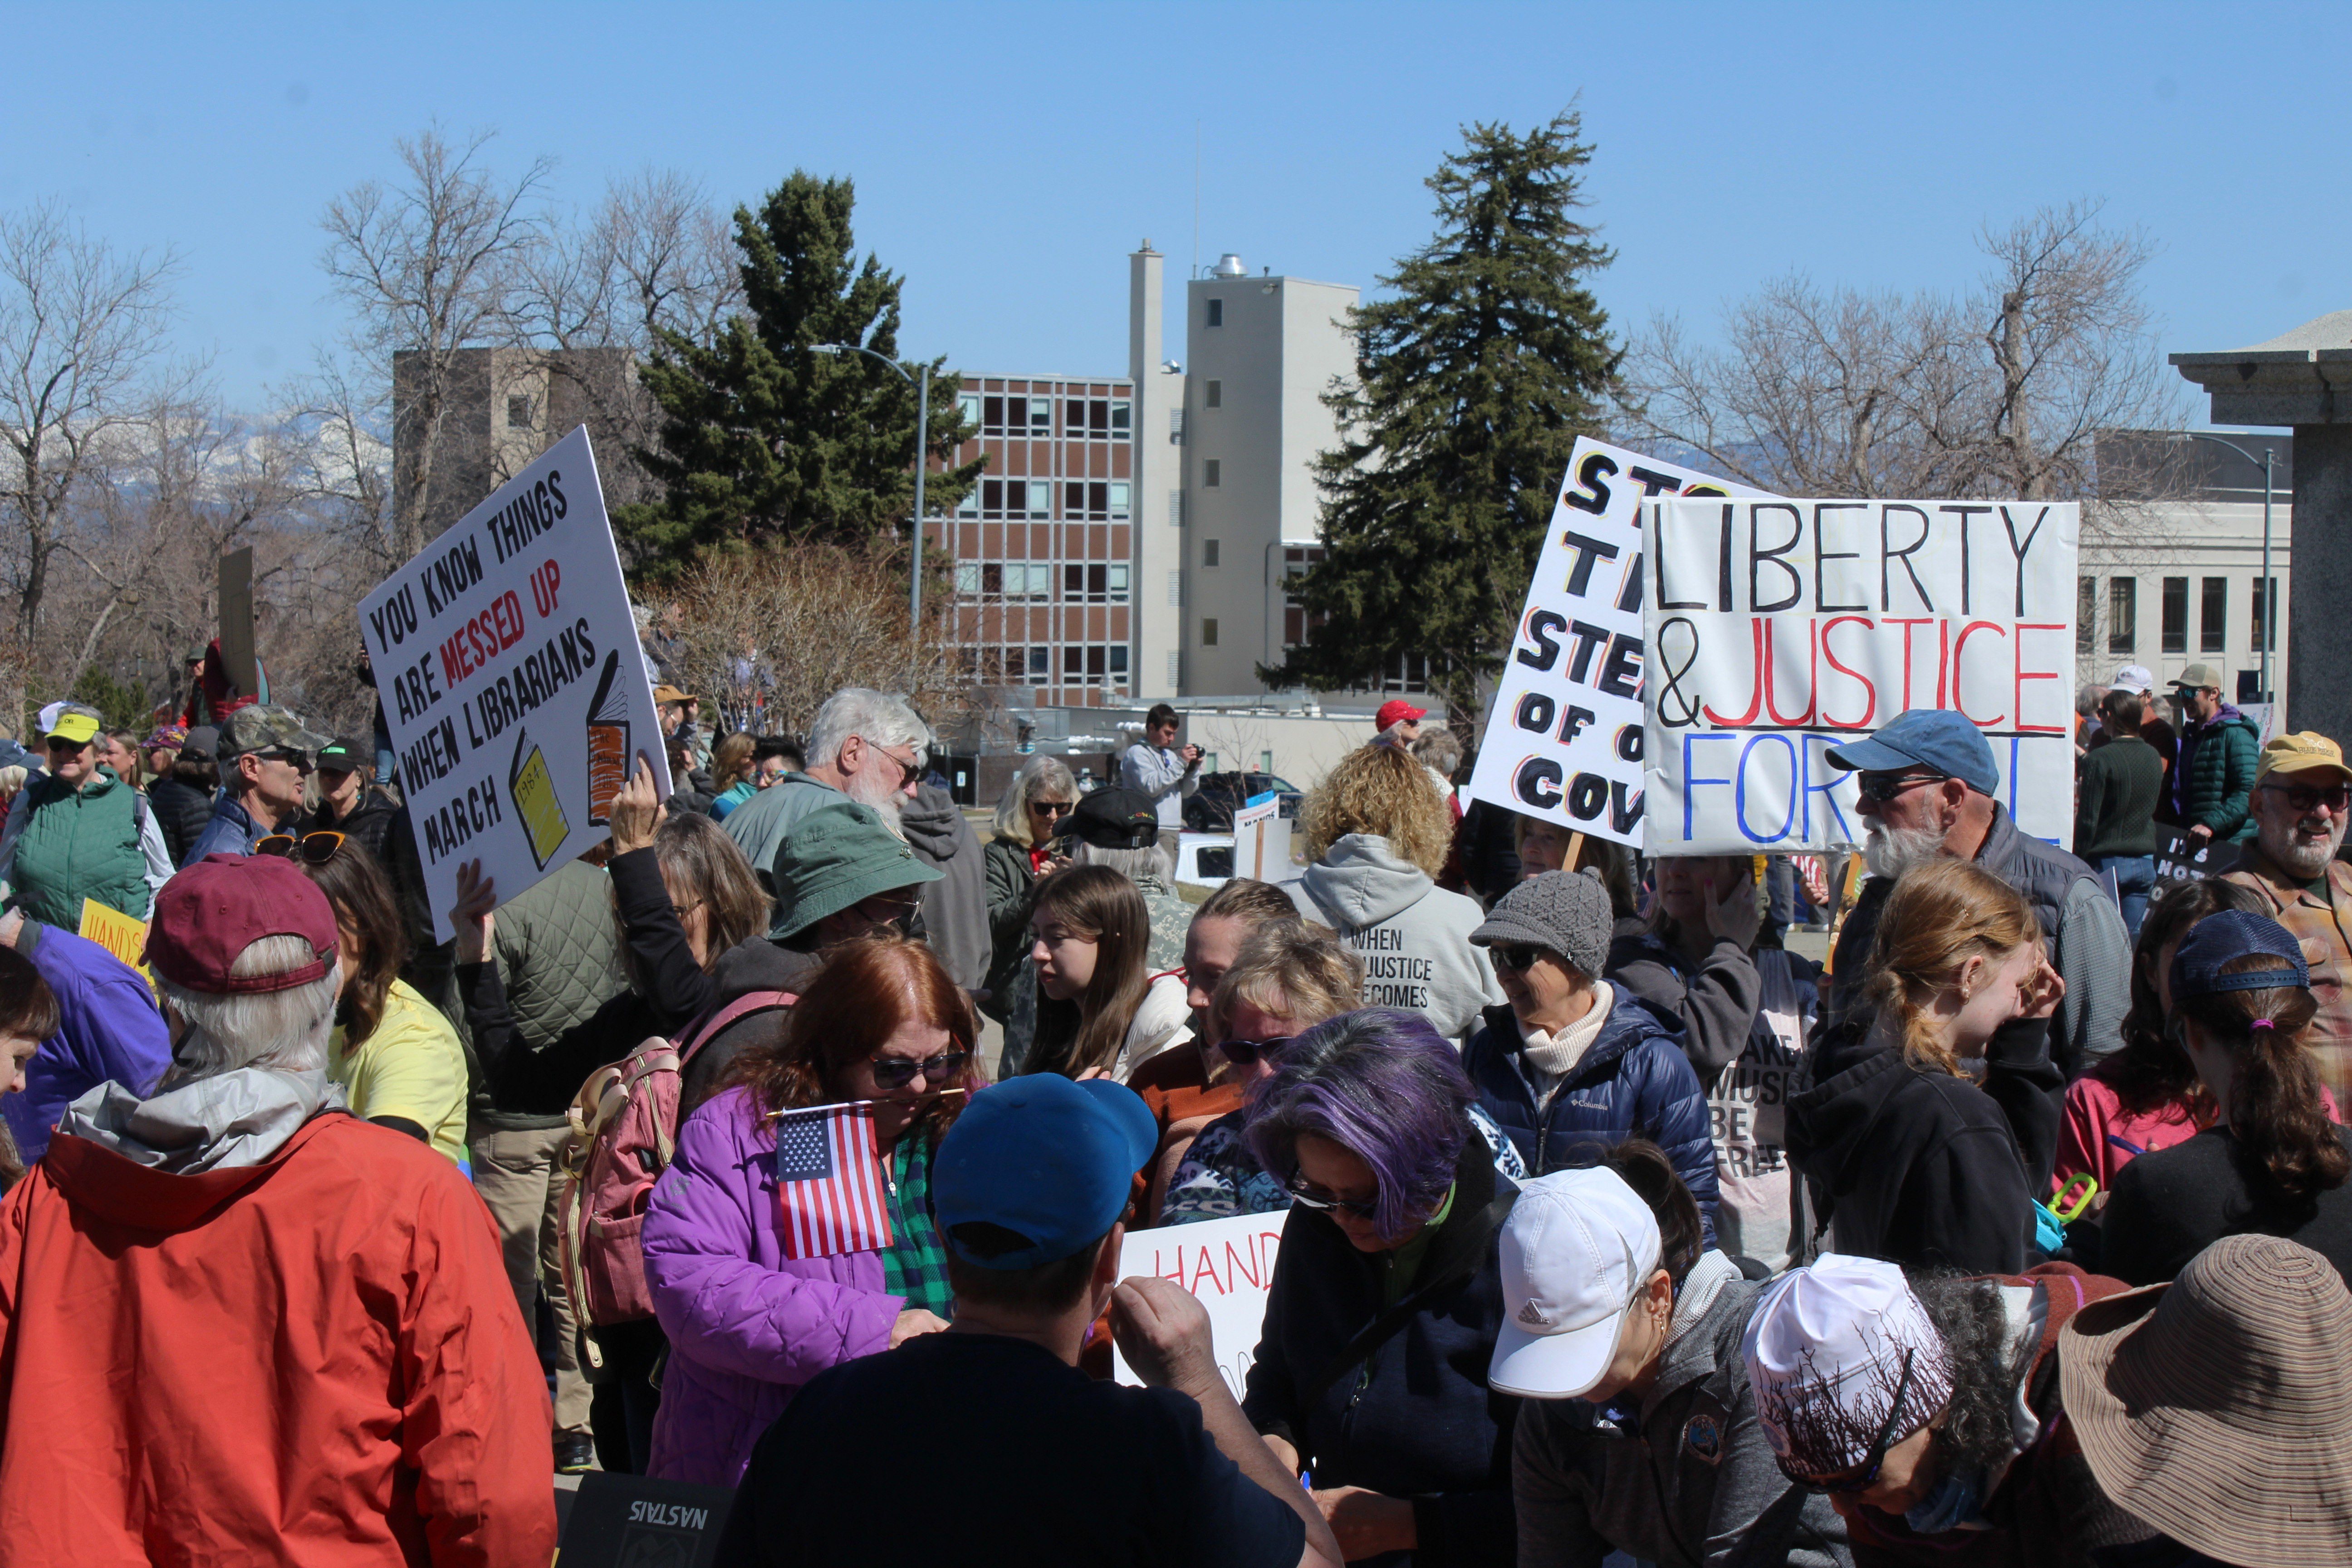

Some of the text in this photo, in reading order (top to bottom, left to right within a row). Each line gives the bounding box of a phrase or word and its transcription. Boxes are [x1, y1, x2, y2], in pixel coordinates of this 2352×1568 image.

[1563, 451, 1733, 529] ST
[369, 470, 568, 655] YOU KNOW THINGS
[1654, 504, 2049, 618] LIBERTY
[394, 559, 561, 726] ARE MESSED UP
[1515, 608, 1644, 703] STE
[1657, 616, 2067, 732] & JUSTICE
[401, 617, 596, 797] WHEN LIBRARIANS
[1512, 692, 1644, 763] OF O
[591, 730, 610, 743] The
[516, 763, 540, 808] 1984
[1683, 733, 1853, 843] FOR
[424, 774, 502, 866] MARCH
[2157, 859, 2206, 881] NOT
[1350, 928, 1402, 950] WHEN
[1363, 956, 1433, 981] JUSTICE
[1362, 984, 1428, 1008] ECOMES
[1737, 1034, 1801, 1068] AKE
[1579, 1100, 1608, 1111] Columbia
[1706, 1066, 1790, 1107] MUSI
[1708, 1105, 1748, 1142] BE
[1714, 1144, 1784, 1179] FREE
[1155, 1232, 1282, 1296] HAND
[1518, 1314, 1550, 1325] adidas
[628, 1500, 708, 1530] NASTAIS
